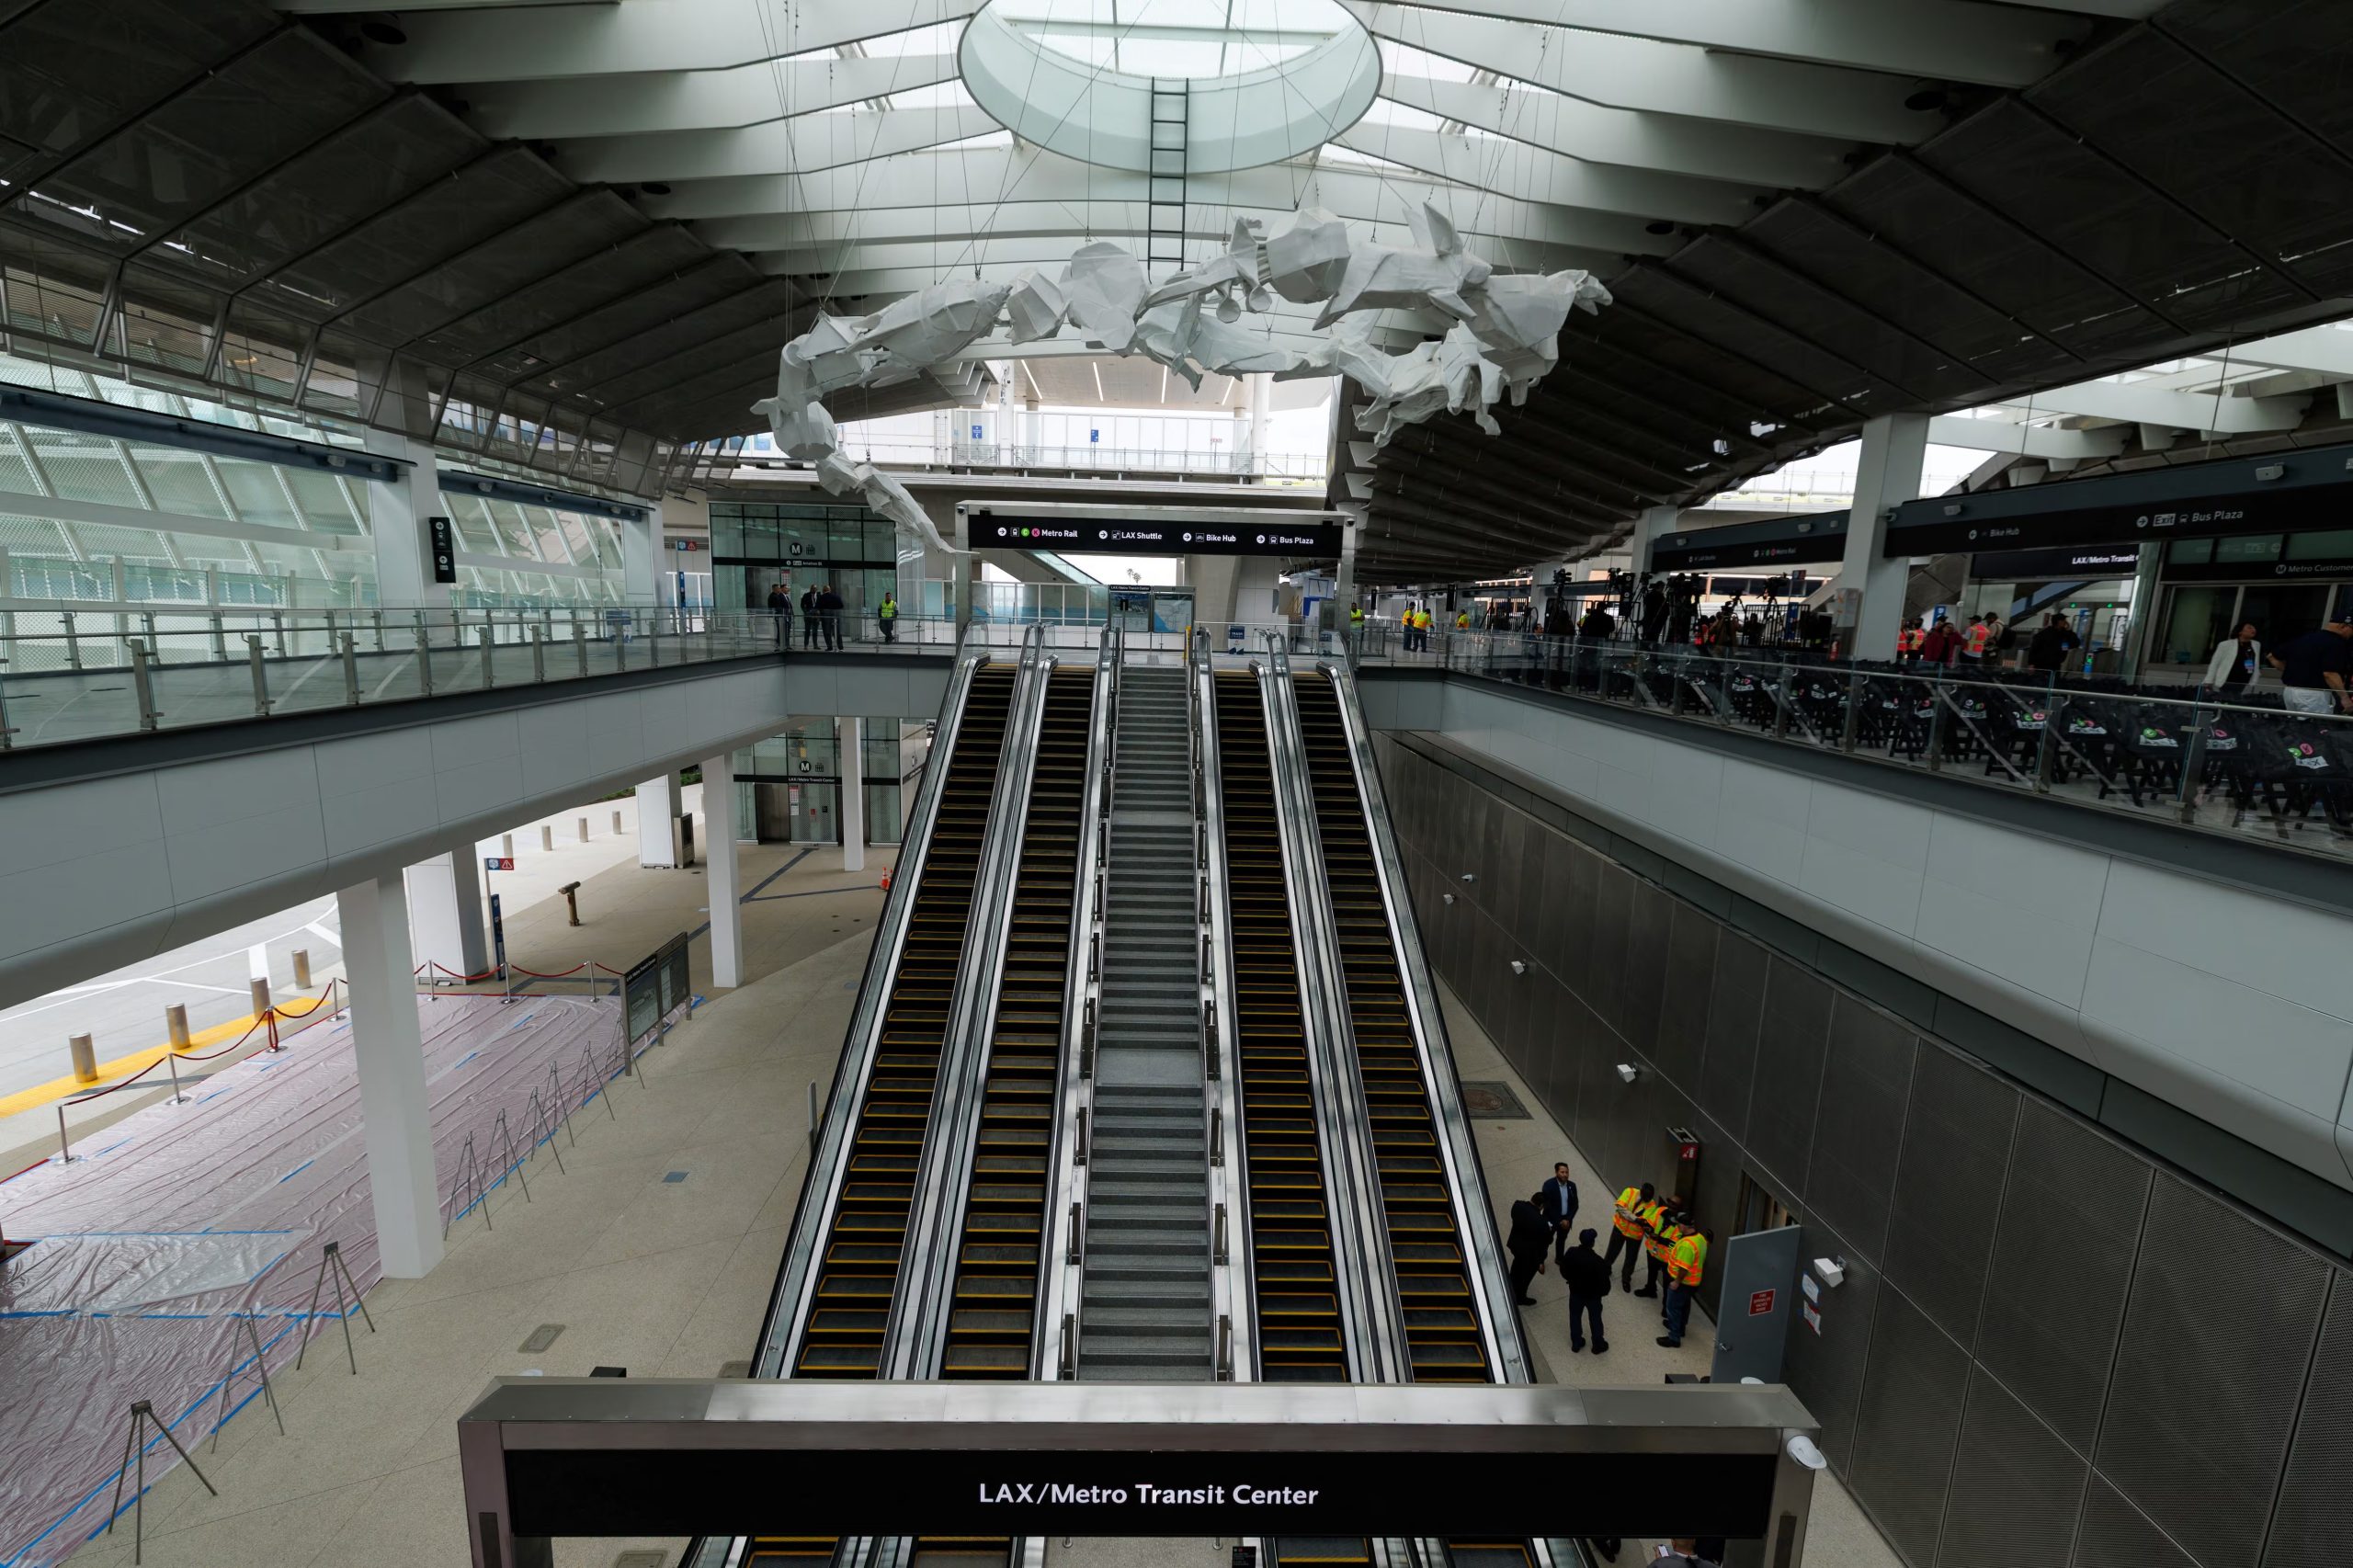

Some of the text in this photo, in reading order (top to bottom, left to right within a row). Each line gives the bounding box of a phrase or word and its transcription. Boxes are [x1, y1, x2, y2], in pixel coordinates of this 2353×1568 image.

[2192, 513, 2211, 522] Bus
[2214, 510, 2244, 520] Plaza
[1063, 529, 1078, 538] Rail
[1121, 531, 1163, 540] LAX Shuttle
[1990, 527, 2020, 537] Bike Hub
[1206, 533, 1237, 543] Bike Hub
[1279, 536, 1314, 545] Bus Plaza
[791, 544, 801, 553] M
[2072, 556, 2110, 564] LAX/Metro
[801, 763, 810, 771] M
[979, 1483, 1319, 1505] LAX/Metro Transit Center
